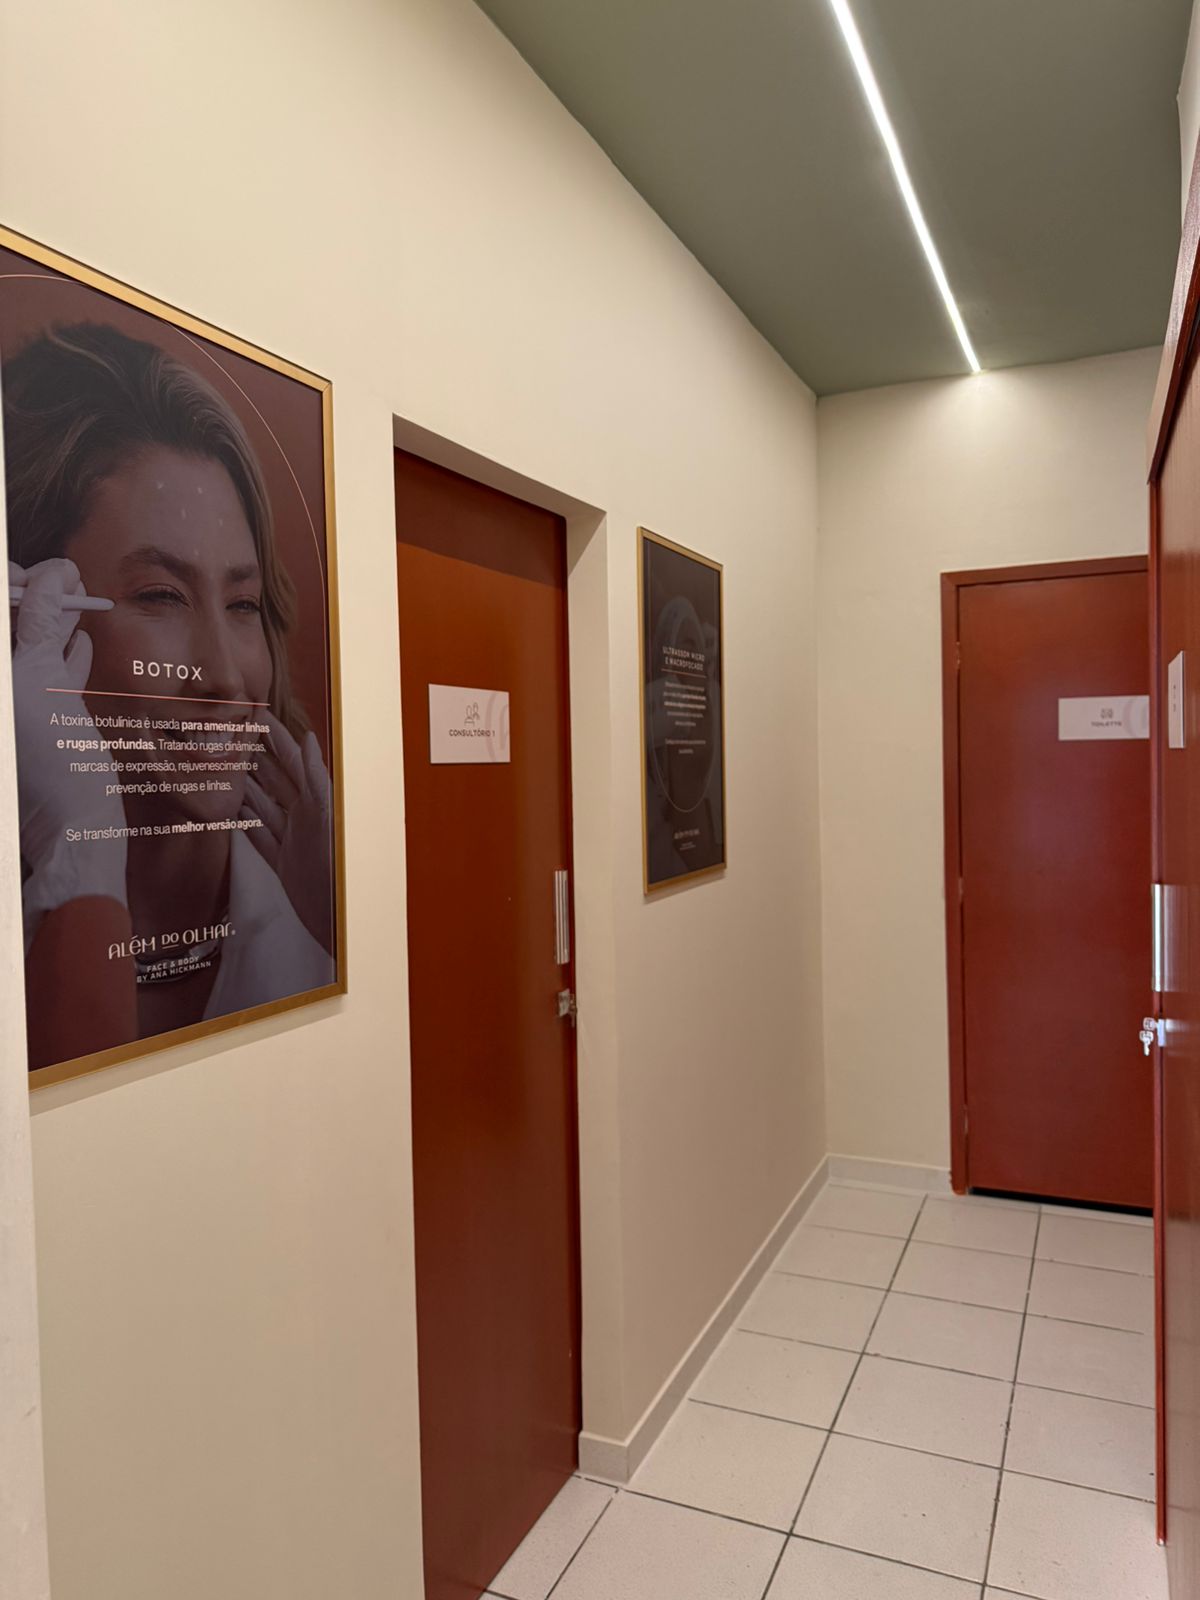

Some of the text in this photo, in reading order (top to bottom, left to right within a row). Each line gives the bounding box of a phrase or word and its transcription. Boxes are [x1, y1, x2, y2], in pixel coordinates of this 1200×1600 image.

[133, 660, 203, 680] BOTOX
[50, 712, 270, 733] A toxina botulínica é usada para amenizar linhas
[449, 728, 491, 737] CONSULTÓRIO
[57, 738, 267, 753] e rugas profundas. Tratando rugas dinâmicas,
[70, 760, 259, 774] marcas de expressão, rejuvenescimento e
[106, 780, 233, 797] prevenção de rugas e linhas.
[66, 817, 264, 842] Se transforme na sua melhor versão agora.
[161, 932, 180, 946] DO
[136, 961, 211, 983] BY ANA HICKMANN
[147, 956, 200, 973] FACE & BODY
